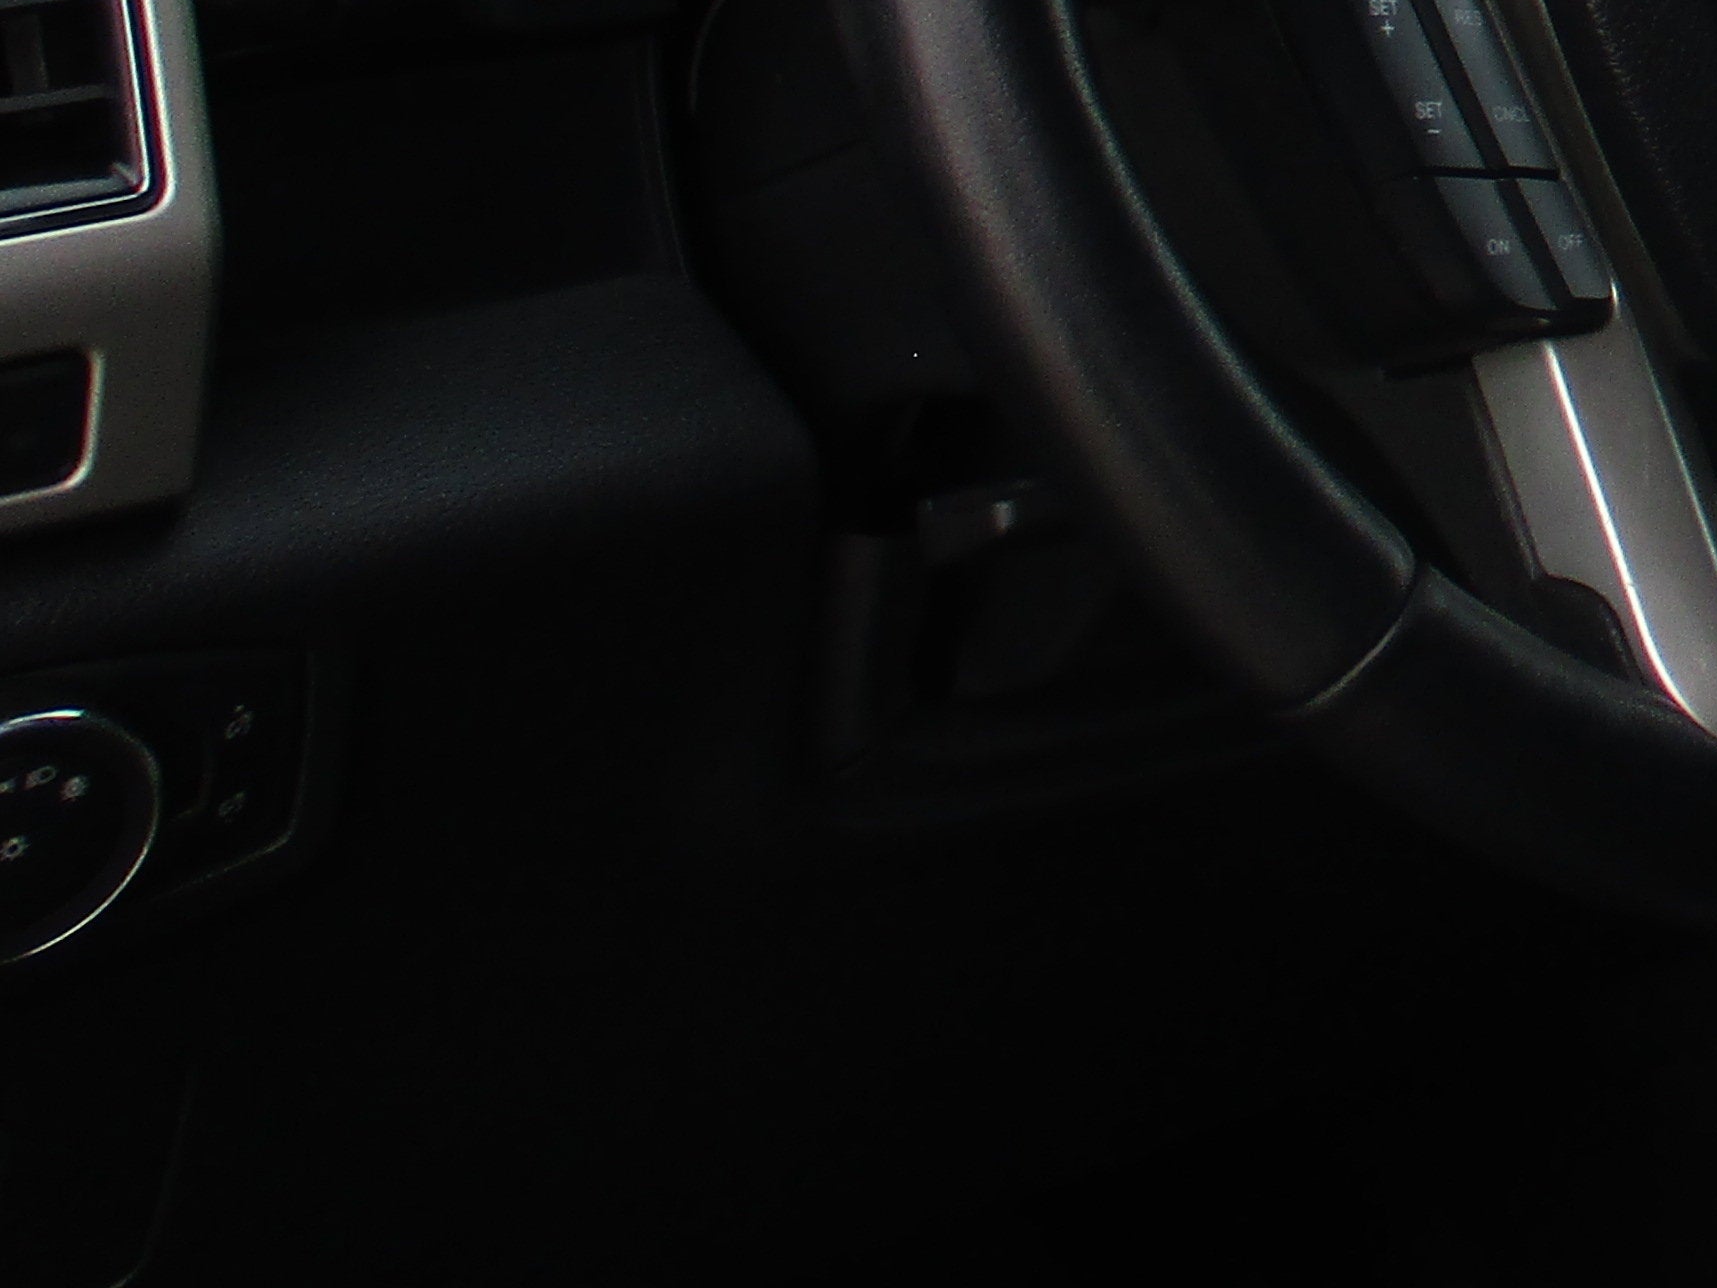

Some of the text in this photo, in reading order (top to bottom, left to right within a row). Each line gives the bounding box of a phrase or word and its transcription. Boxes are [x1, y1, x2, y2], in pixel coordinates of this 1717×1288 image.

[1415, 100, 1444, 120] SET
[1493, 104, 1530, 124] CNCL
[1486, 237, 1512, 257] ON
[1557, 232, 1585, 252] OFF
